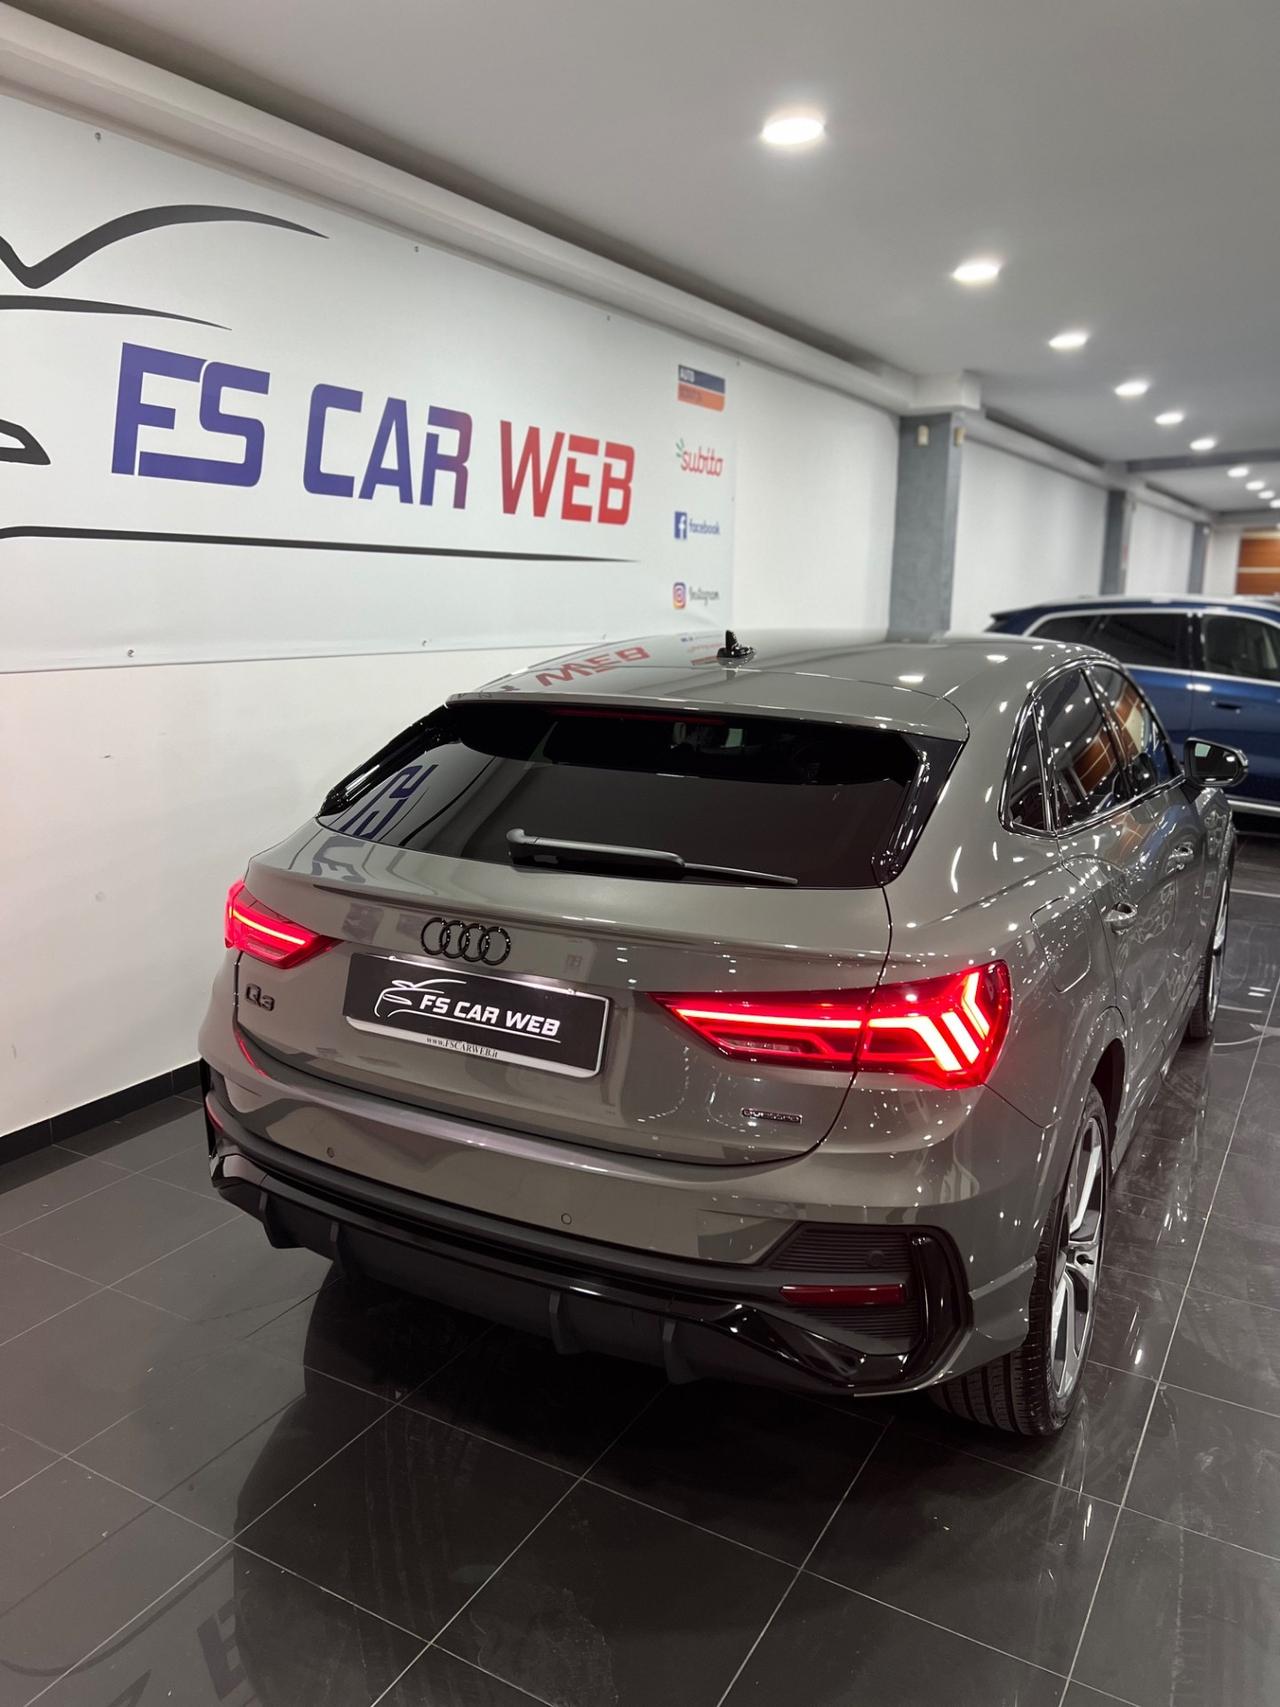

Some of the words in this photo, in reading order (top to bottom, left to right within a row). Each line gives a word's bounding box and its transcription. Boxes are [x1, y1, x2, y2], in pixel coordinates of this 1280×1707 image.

[111, 342, 271, 488] FS
[303, 383, 473, 510] CAR
[500, 420, 636, 526] WEB
[681, 446, 723, 476] subito
[246, 983, 275, 1012] Q3
[420, 994, 450, 1014] FS
[453, 1002, 500, 1024] CAR
[505, 1011, 561, 1037] WEB
[426, 1036, 498, 1058] www.FSCARWEB.it
